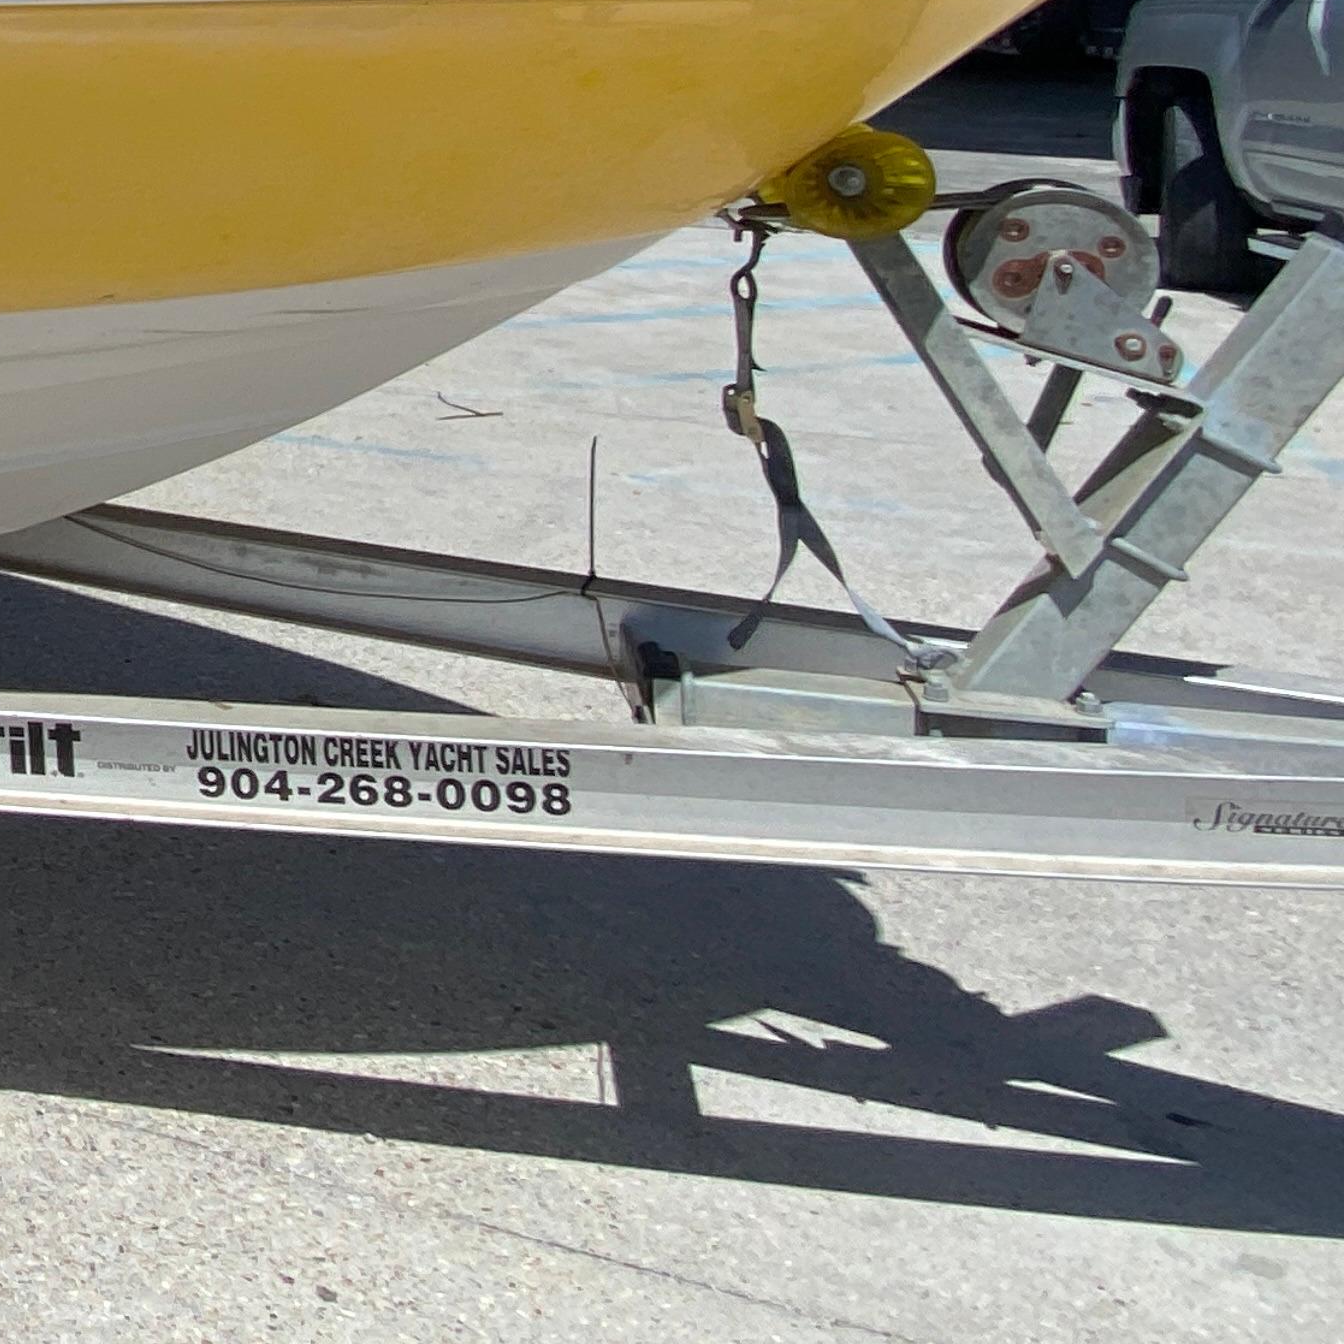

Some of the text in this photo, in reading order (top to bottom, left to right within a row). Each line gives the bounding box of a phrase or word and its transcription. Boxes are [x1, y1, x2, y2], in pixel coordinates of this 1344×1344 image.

[96, 760, 161, 772] DISTRIBUTED
[187, 729, 572, 777] JULINGTON CREEK YACHT SALES
[197, 766, 572, 816] 904-268-0098
